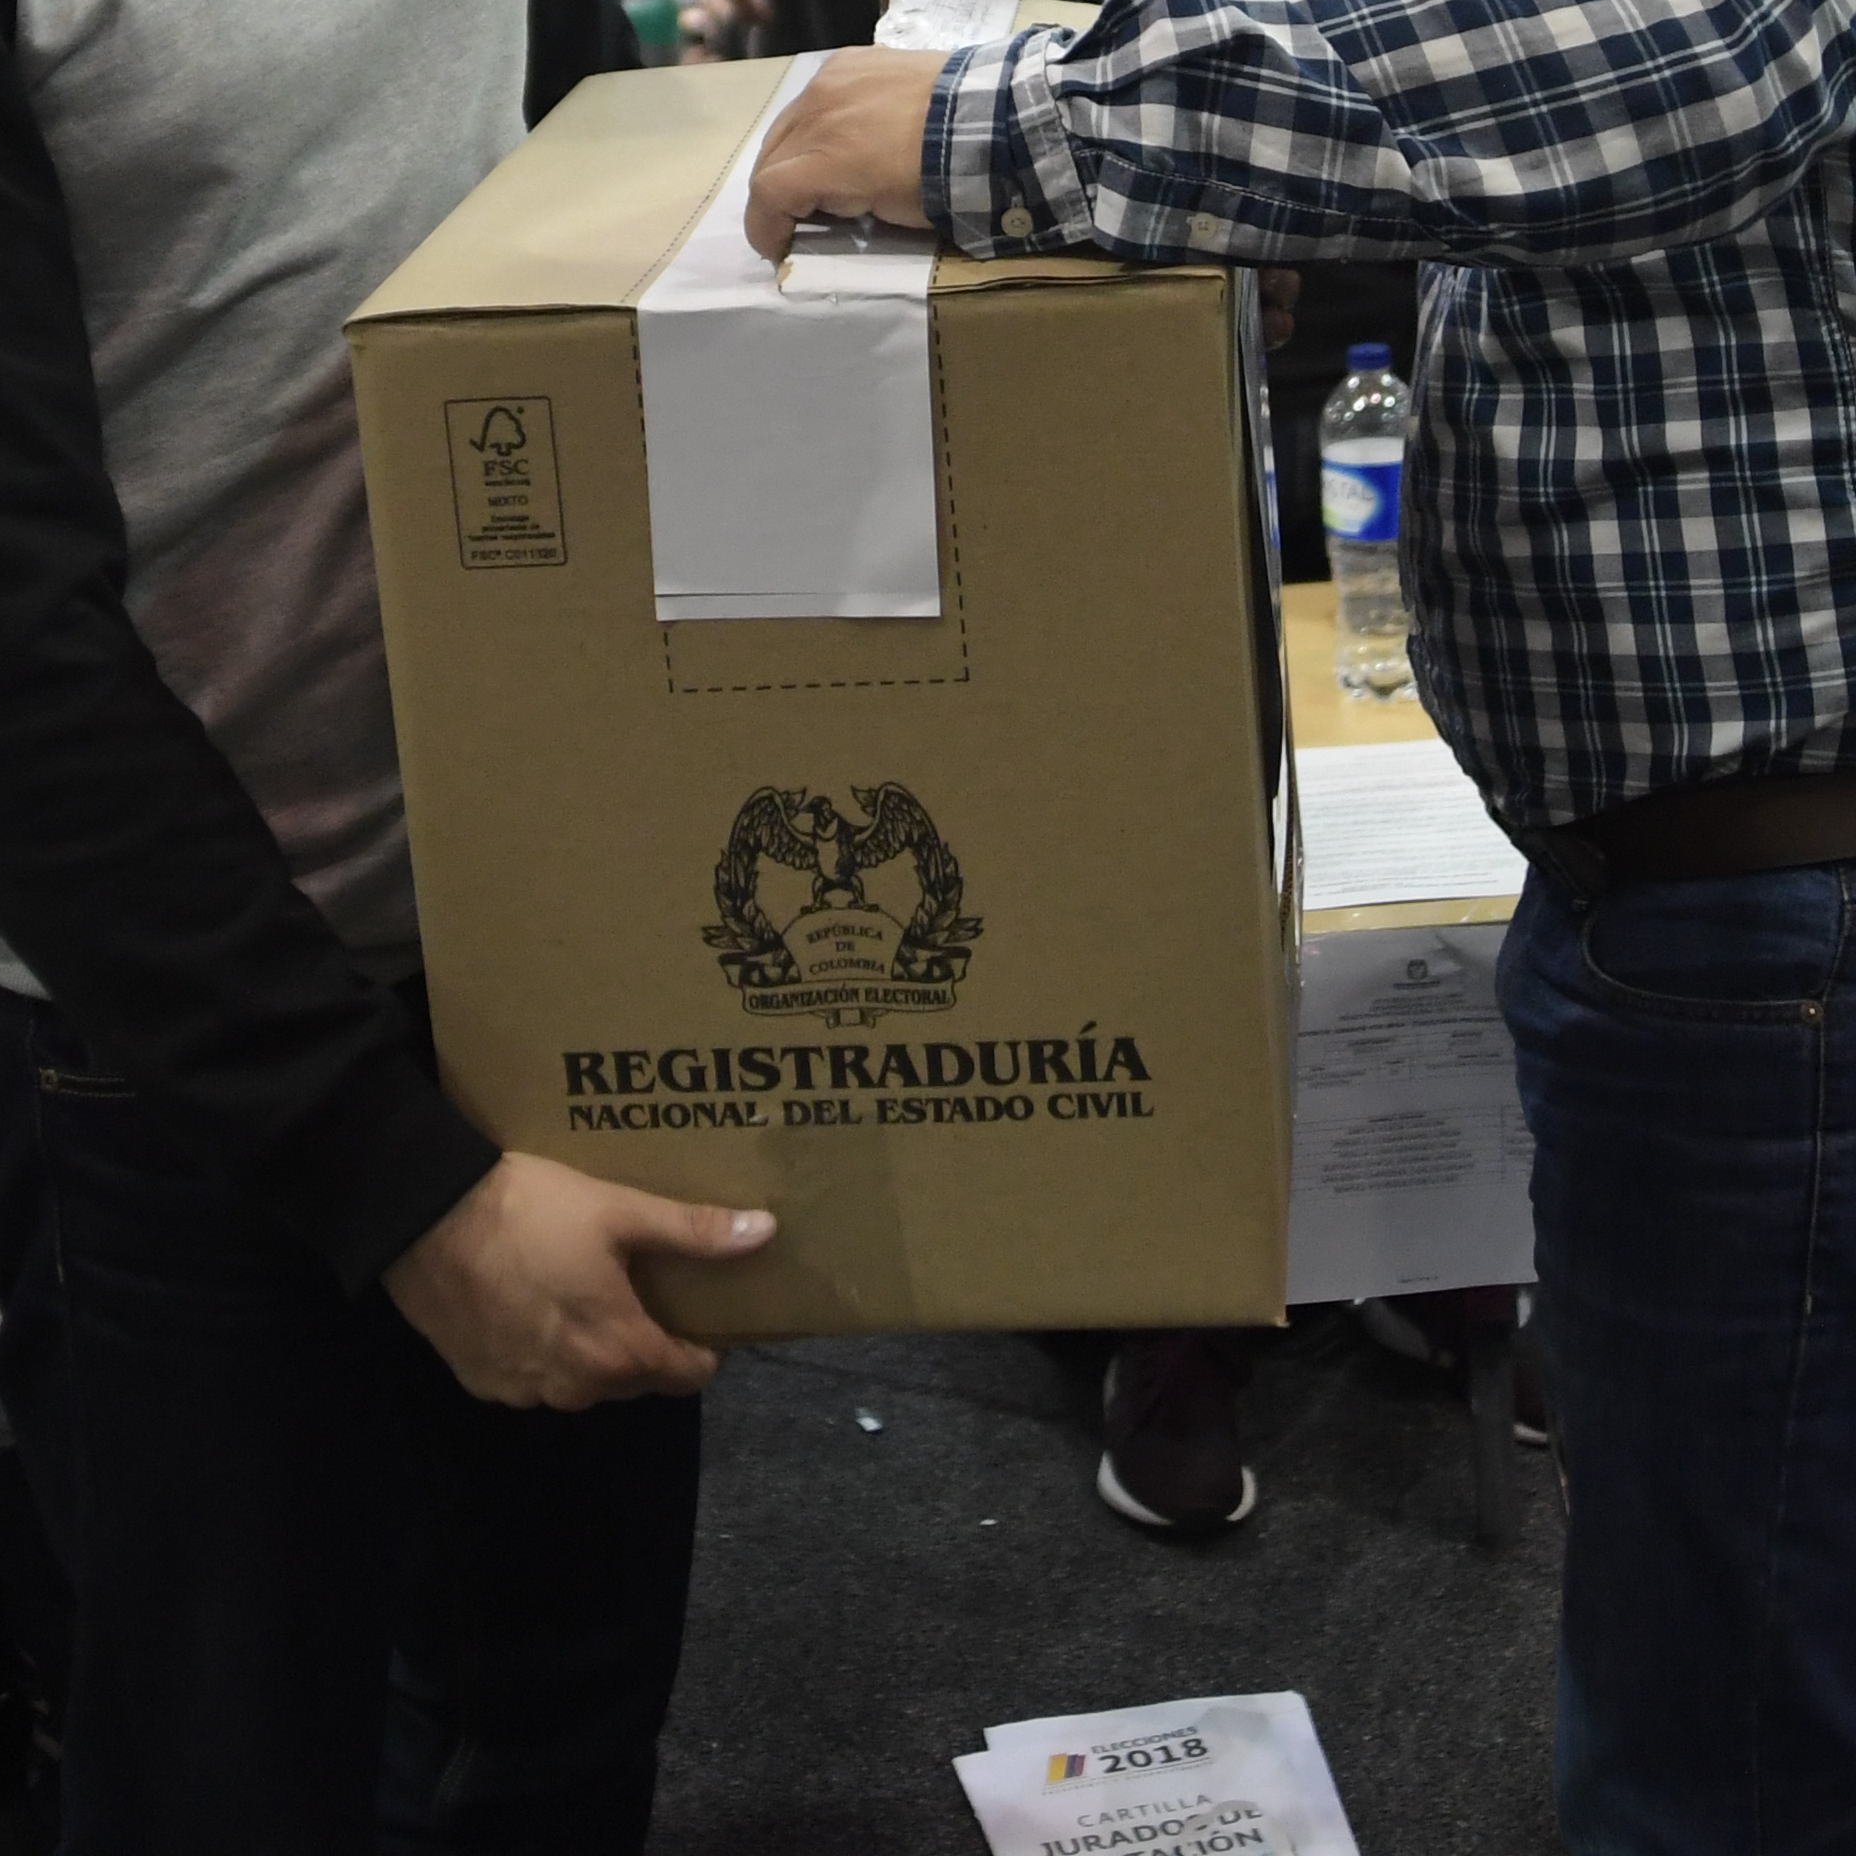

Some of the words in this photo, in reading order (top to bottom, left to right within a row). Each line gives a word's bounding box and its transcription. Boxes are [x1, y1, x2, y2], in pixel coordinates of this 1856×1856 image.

[483, 459, 529, 477] FSC
[806, 923, 883, 944] REPÚBLICA
[835, 941, 855, 952] DE
[809, 957, 885, 975] COLOMBIA
[748, 984, 860, 1010] ORGANIZACIÓN
[864, 987, 950, 1006] ELECTORAL
[562, 1021, 1153, 1097] REGISTRADURÍA
[568, 1099, 770, 1131] NACIONAL
[783, 1098, 862, 1126] DEL
[876, 1095, 1036, 1125] ESTADO
[1047, 1091, 1155, 1121] CIVIL
[1091, 1725, 1198, 1754] ELECCIONES
[1099, 1738, 1209, 1774] 2018
[1077, 1794, 1213, 1828] CARTILLA
